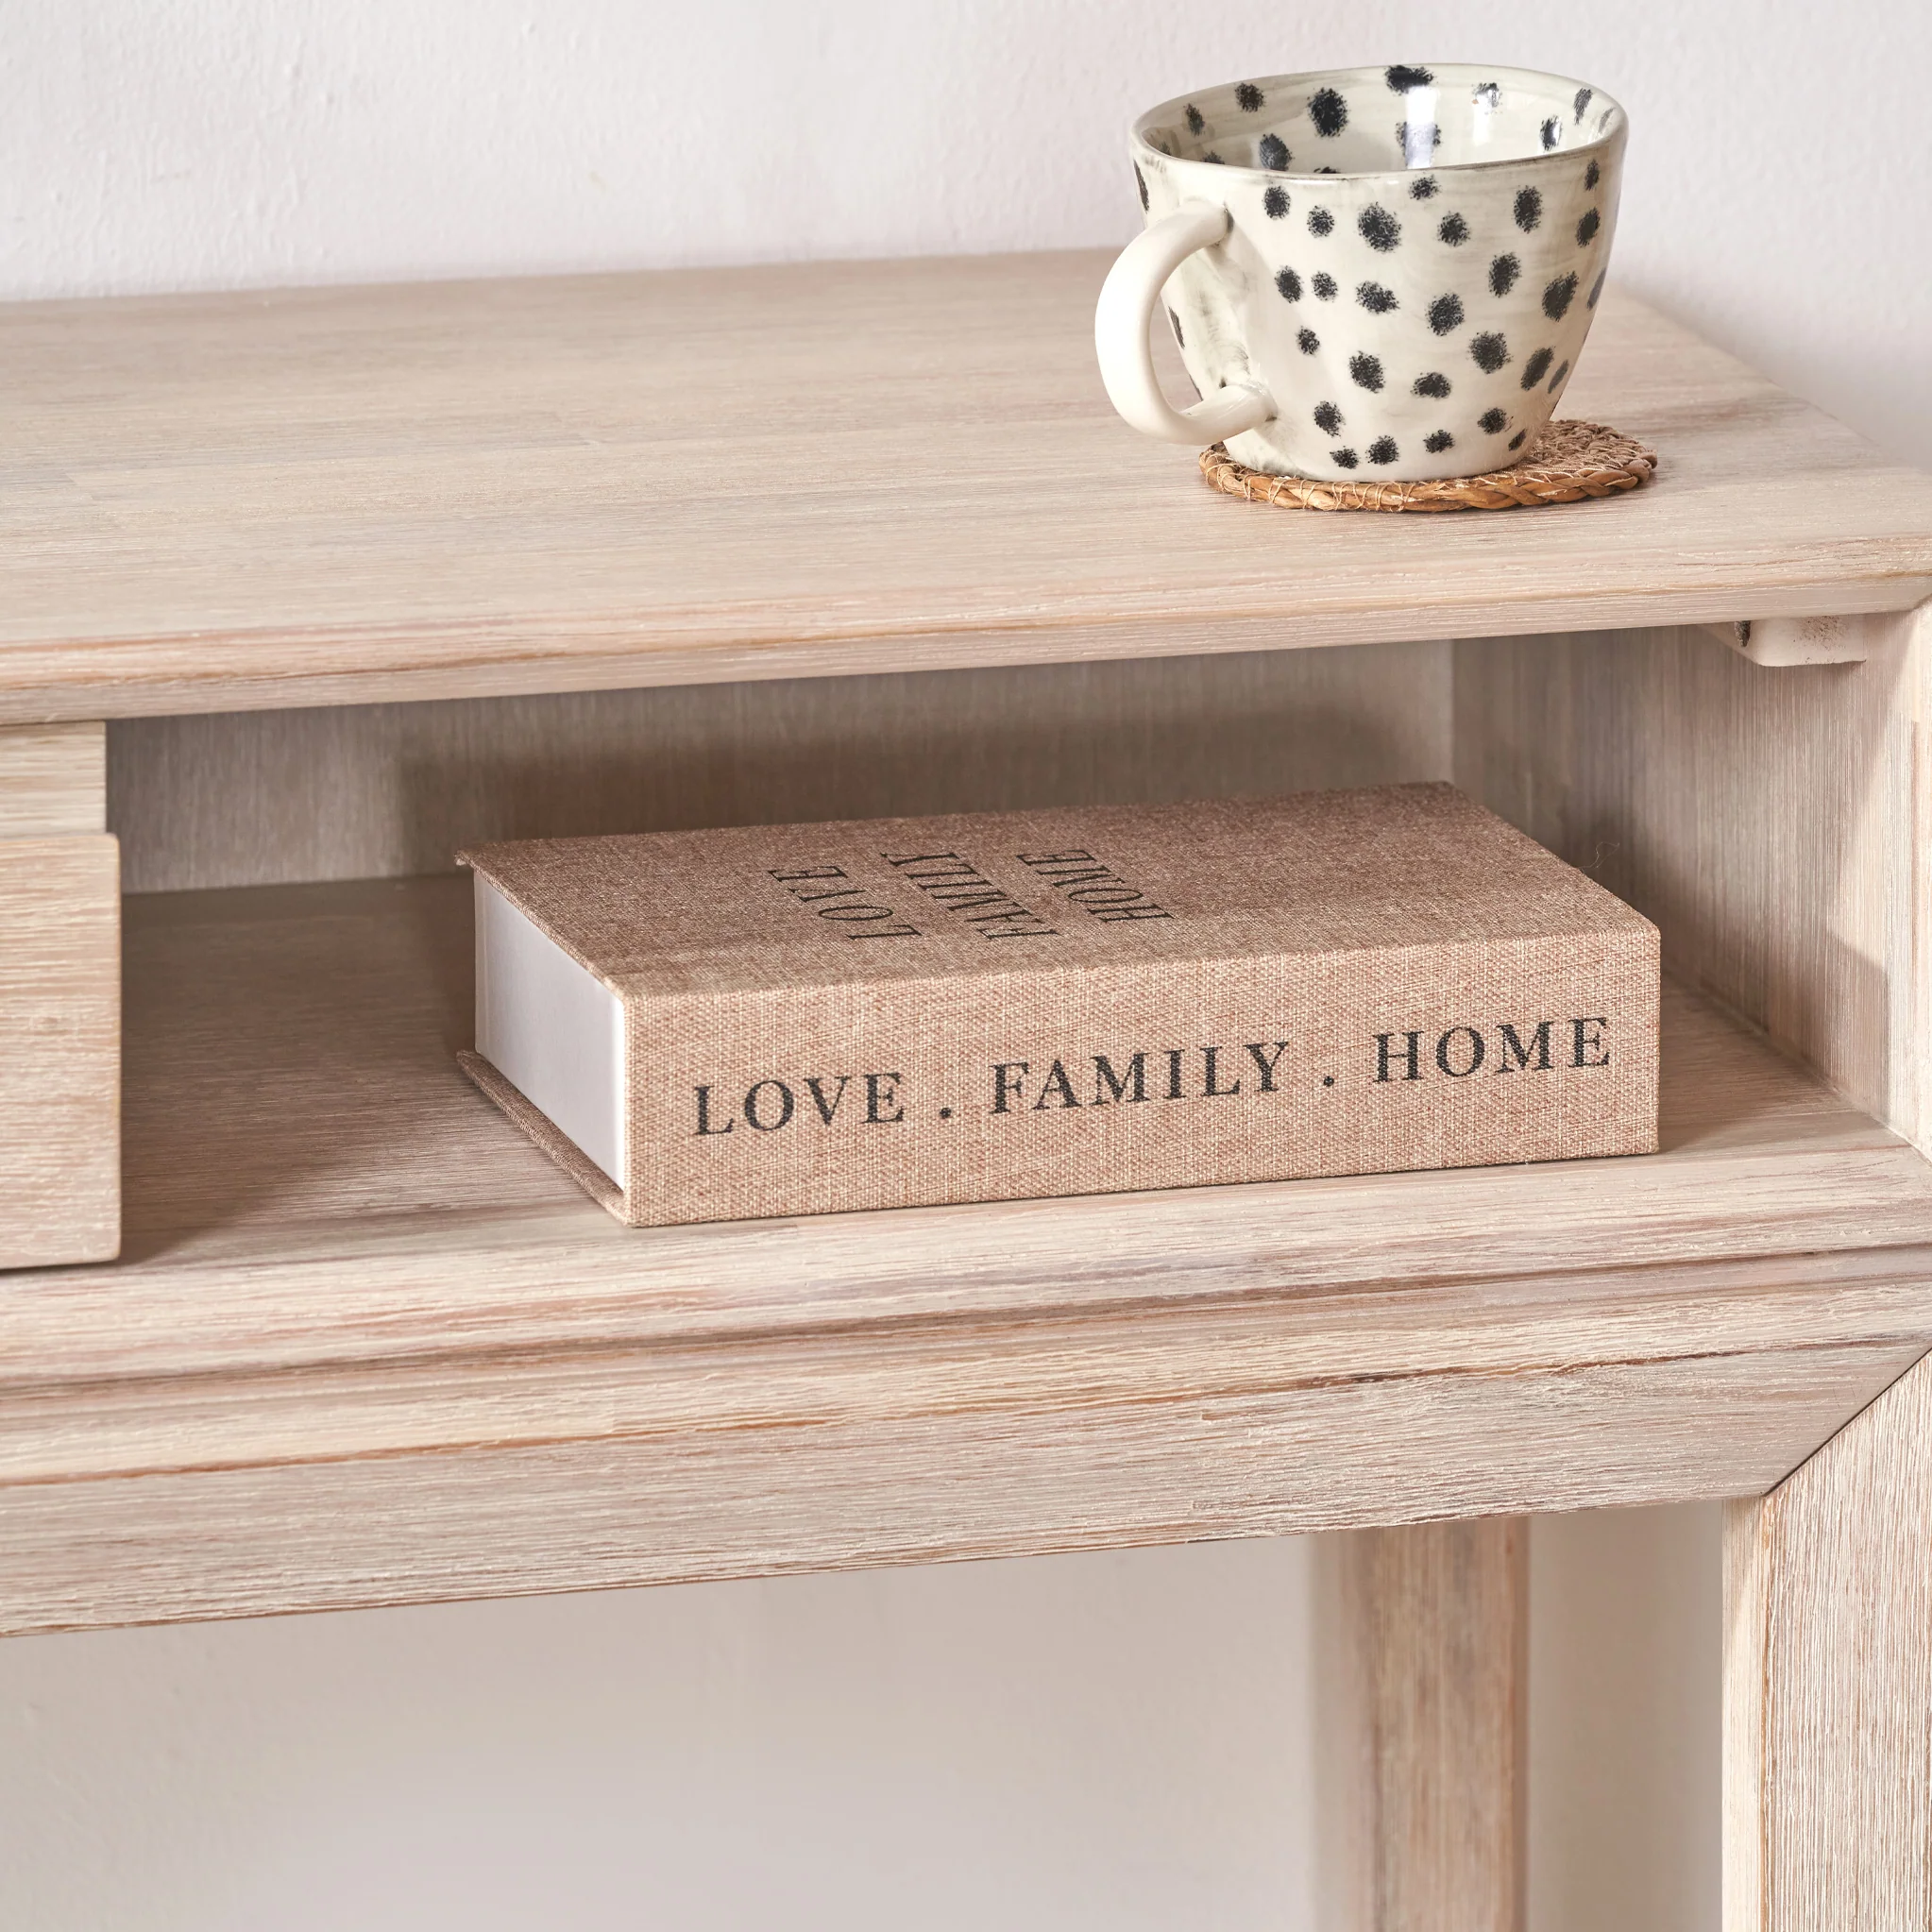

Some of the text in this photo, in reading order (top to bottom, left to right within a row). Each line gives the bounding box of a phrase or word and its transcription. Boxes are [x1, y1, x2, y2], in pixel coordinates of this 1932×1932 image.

[768, 866, 923, 941] LOVE
[879, 852, 1061, 941] FAMILY
[1016, 850, 1176, 923] HOME
[693, 1073, 905, 1135] LOVE
[988, 1042, 1290, 1115] FAMILY
[1372, 1016, 1611, 1084] HOME
